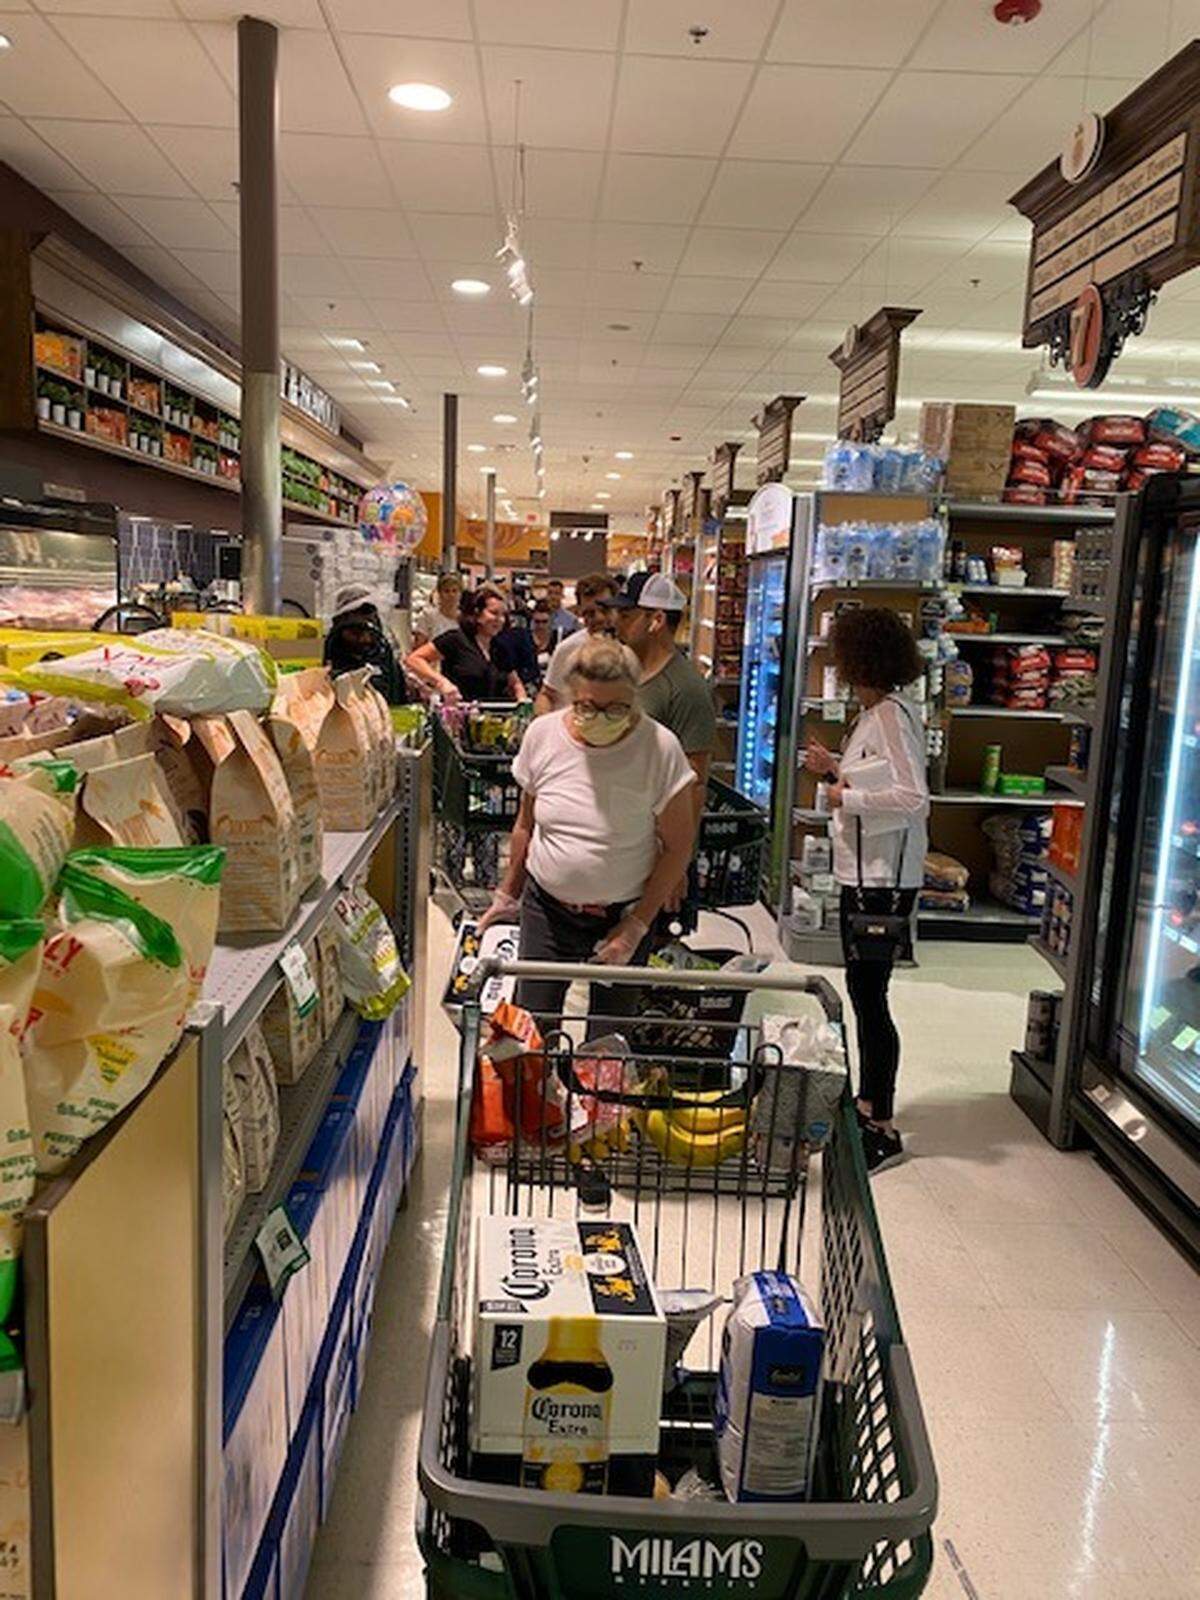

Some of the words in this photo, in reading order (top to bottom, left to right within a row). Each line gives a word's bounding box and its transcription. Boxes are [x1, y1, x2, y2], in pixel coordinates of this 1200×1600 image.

[501, 1228, 551, 1299] Corona
[501, 1329, 518, 1349] 12
[531, 1395, 603, 1421] Corona
[548, 1419, 589, 1436] Extra
